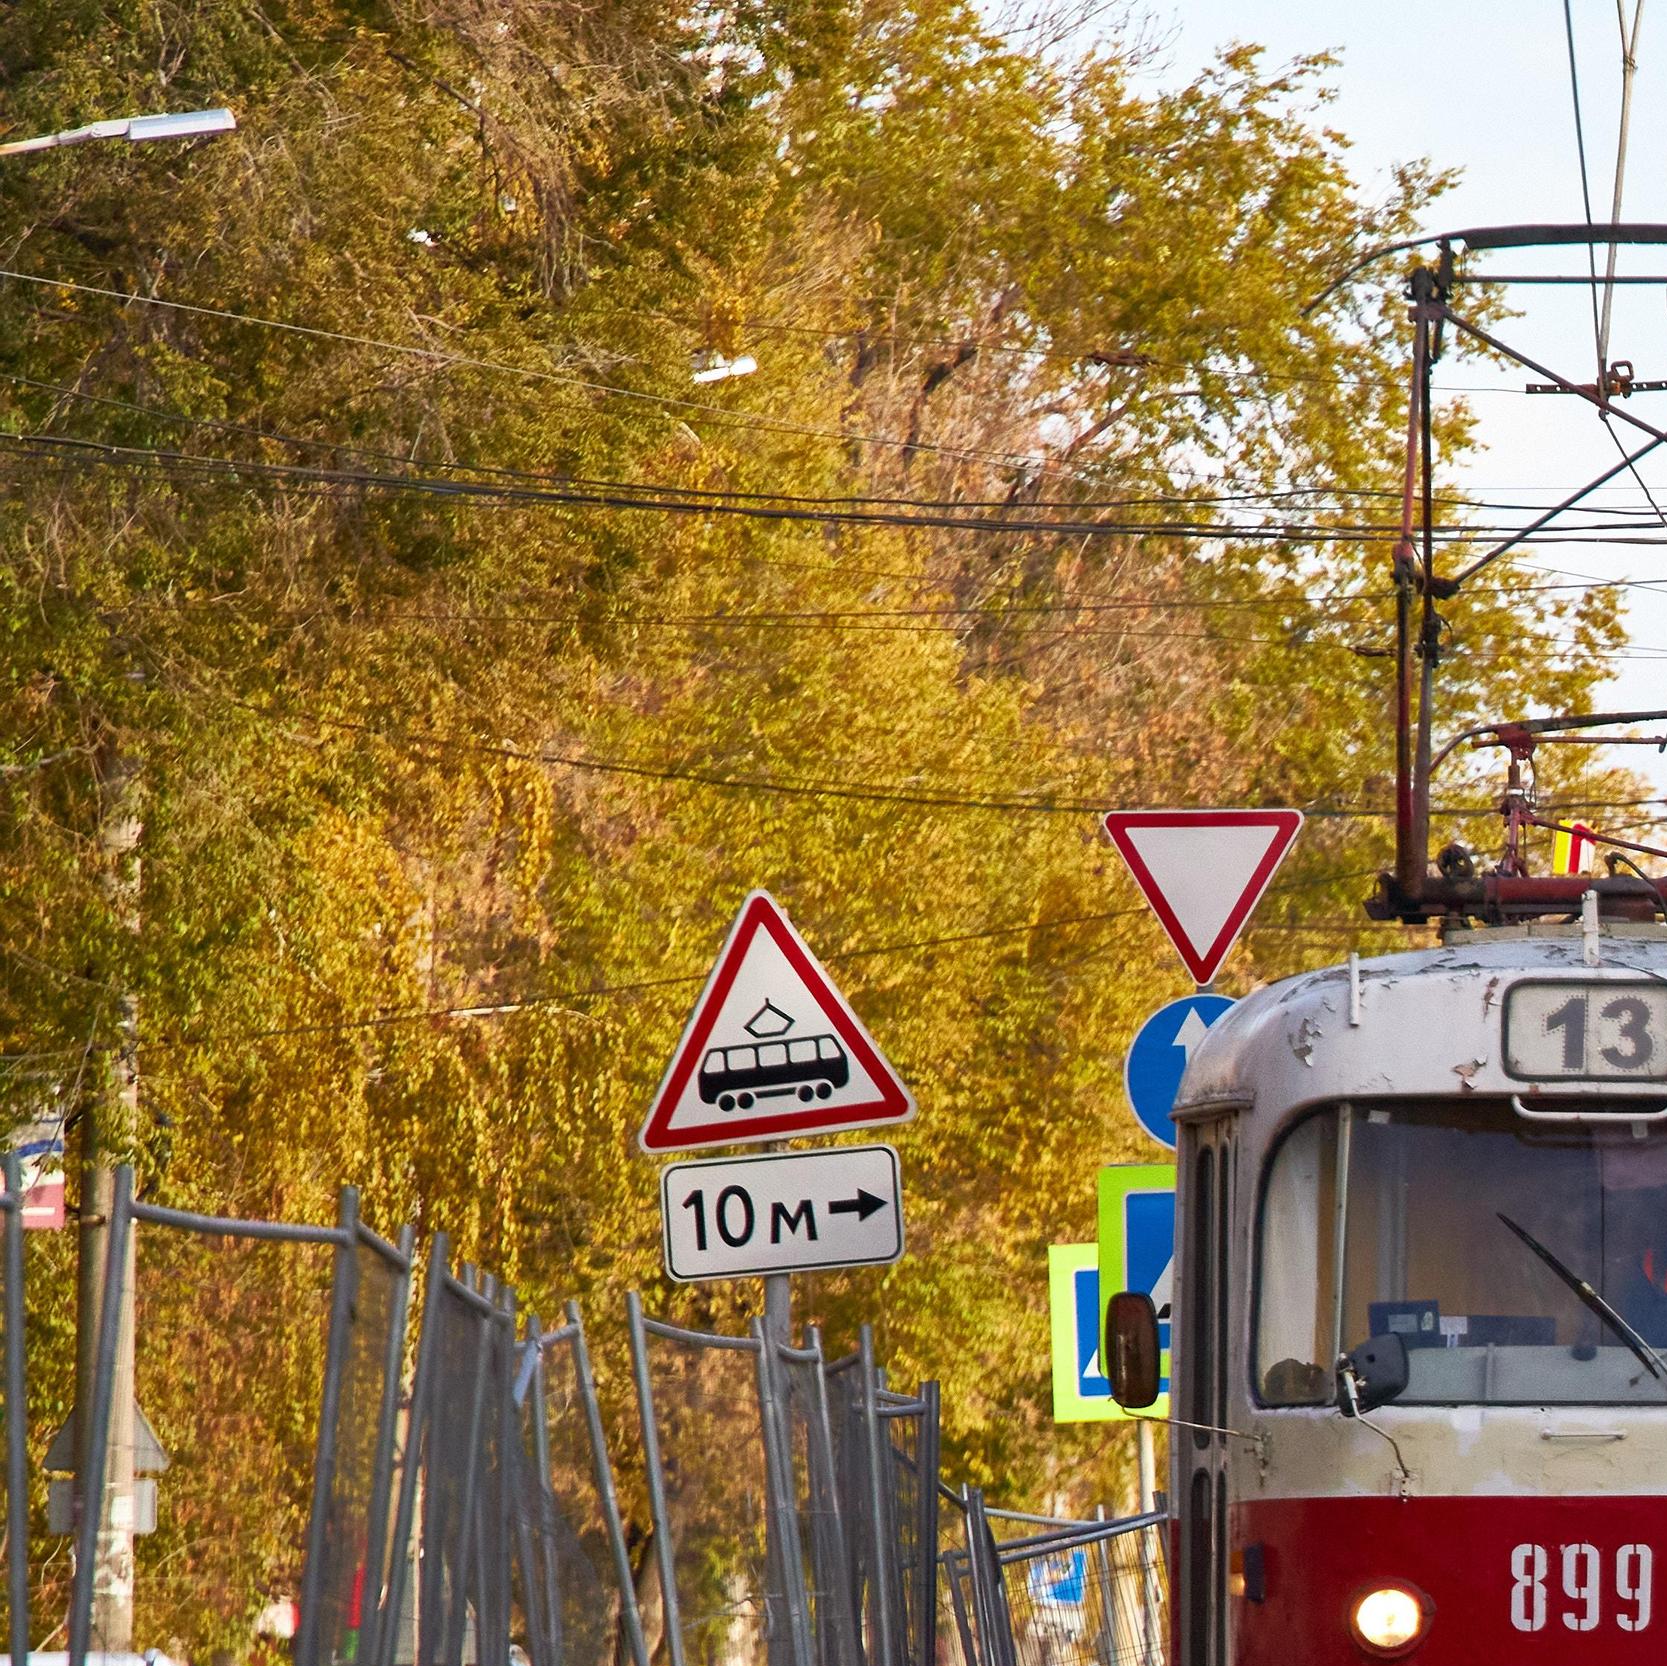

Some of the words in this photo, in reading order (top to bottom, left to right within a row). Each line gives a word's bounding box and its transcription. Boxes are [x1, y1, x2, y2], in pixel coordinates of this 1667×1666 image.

[1543, 997, 1655, 1071] 13
[681, 1183, 754, 1251] 10
[1510, 1542, 1653, 1633] 899
